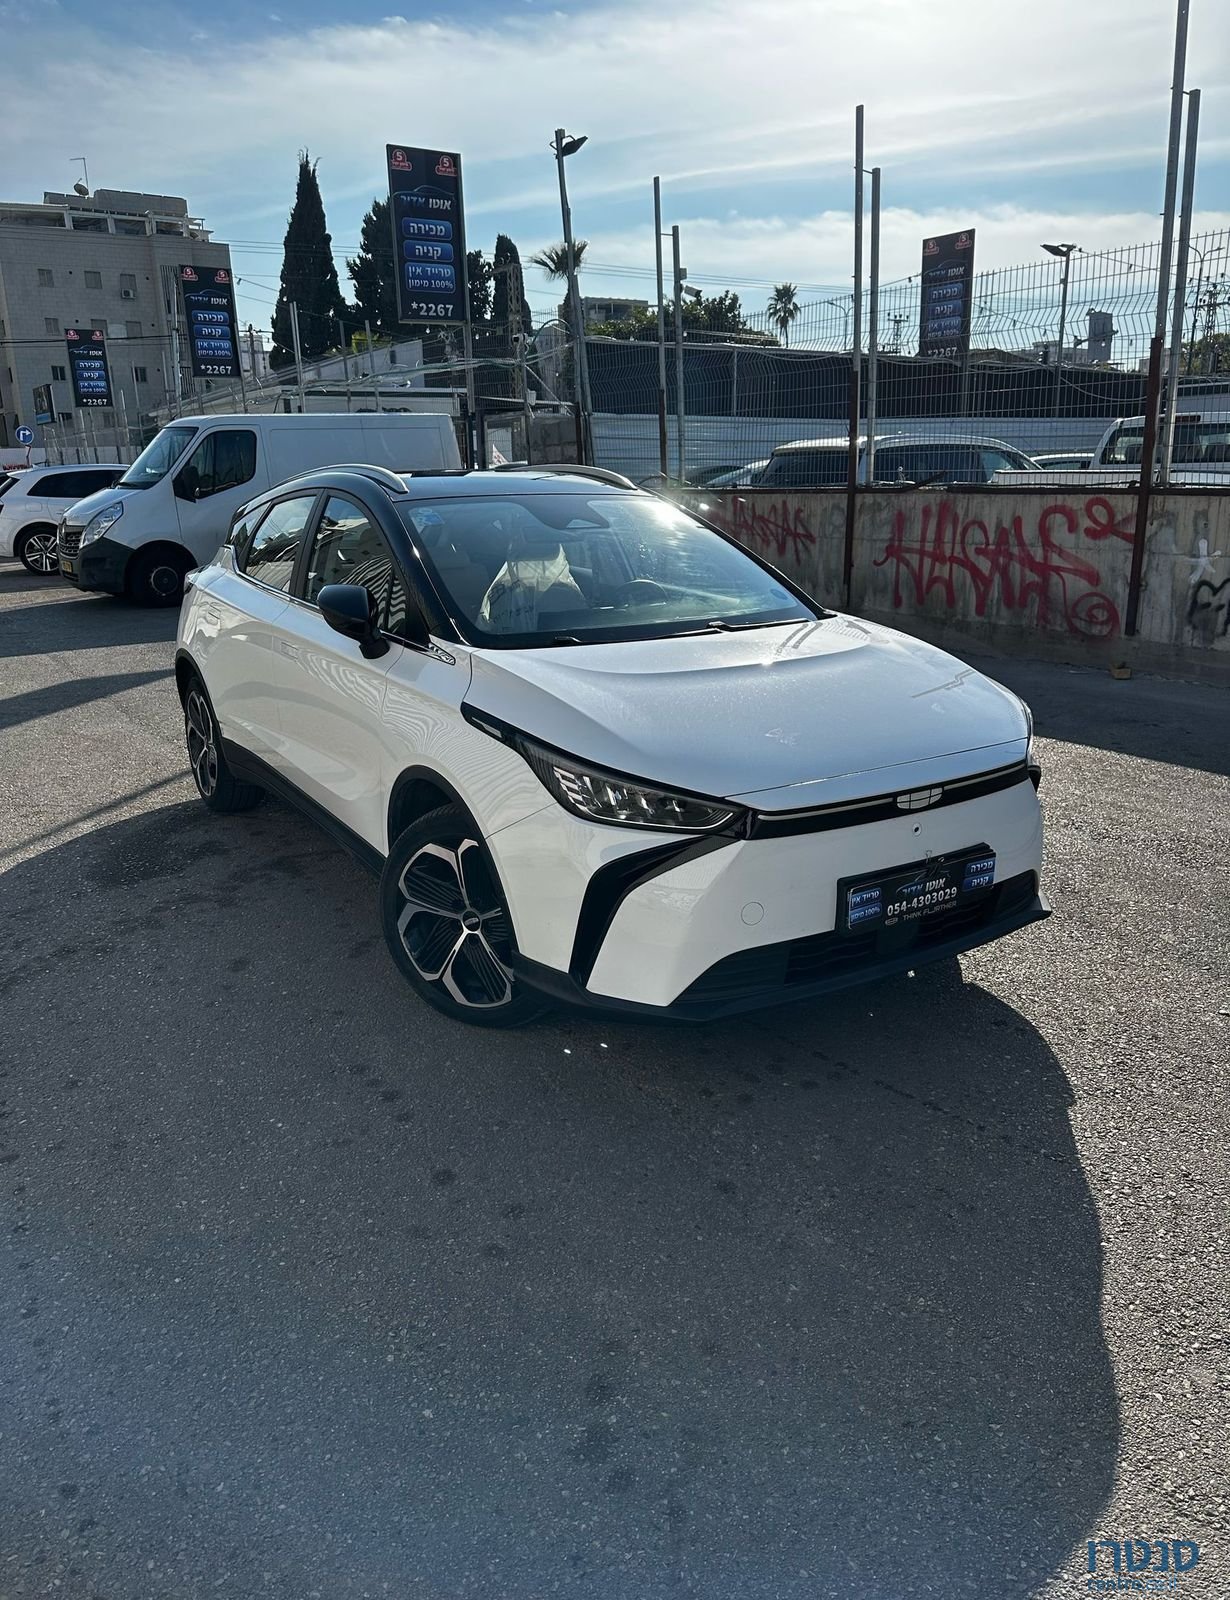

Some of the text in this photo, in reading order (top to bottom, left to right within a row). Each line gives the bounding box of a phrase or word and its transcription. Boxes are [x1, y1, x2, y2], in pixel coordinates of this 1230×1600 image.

[396, 152, 402, 161] 5
[443, 158, 450, 167] 5
[429, 198, 452, 210] אוטו
[409, 222, 445, 236] מכירה
[415, 245, 441, 261] קניה
[408, 266, 451, 278] טרייד אין
[431, 280, 453, 289] 100%
[211, 297, 228, 305] אוטו
[197, 314, 223, 322] מכירה
[202, 328, 221, 338] קניה
[970, 860, 993, 873] מכירה
[925, 878, 946, 891] אוטו
[971, 876, 989, 887] קניה
[887, 887, 958, 916] 054-4303029
